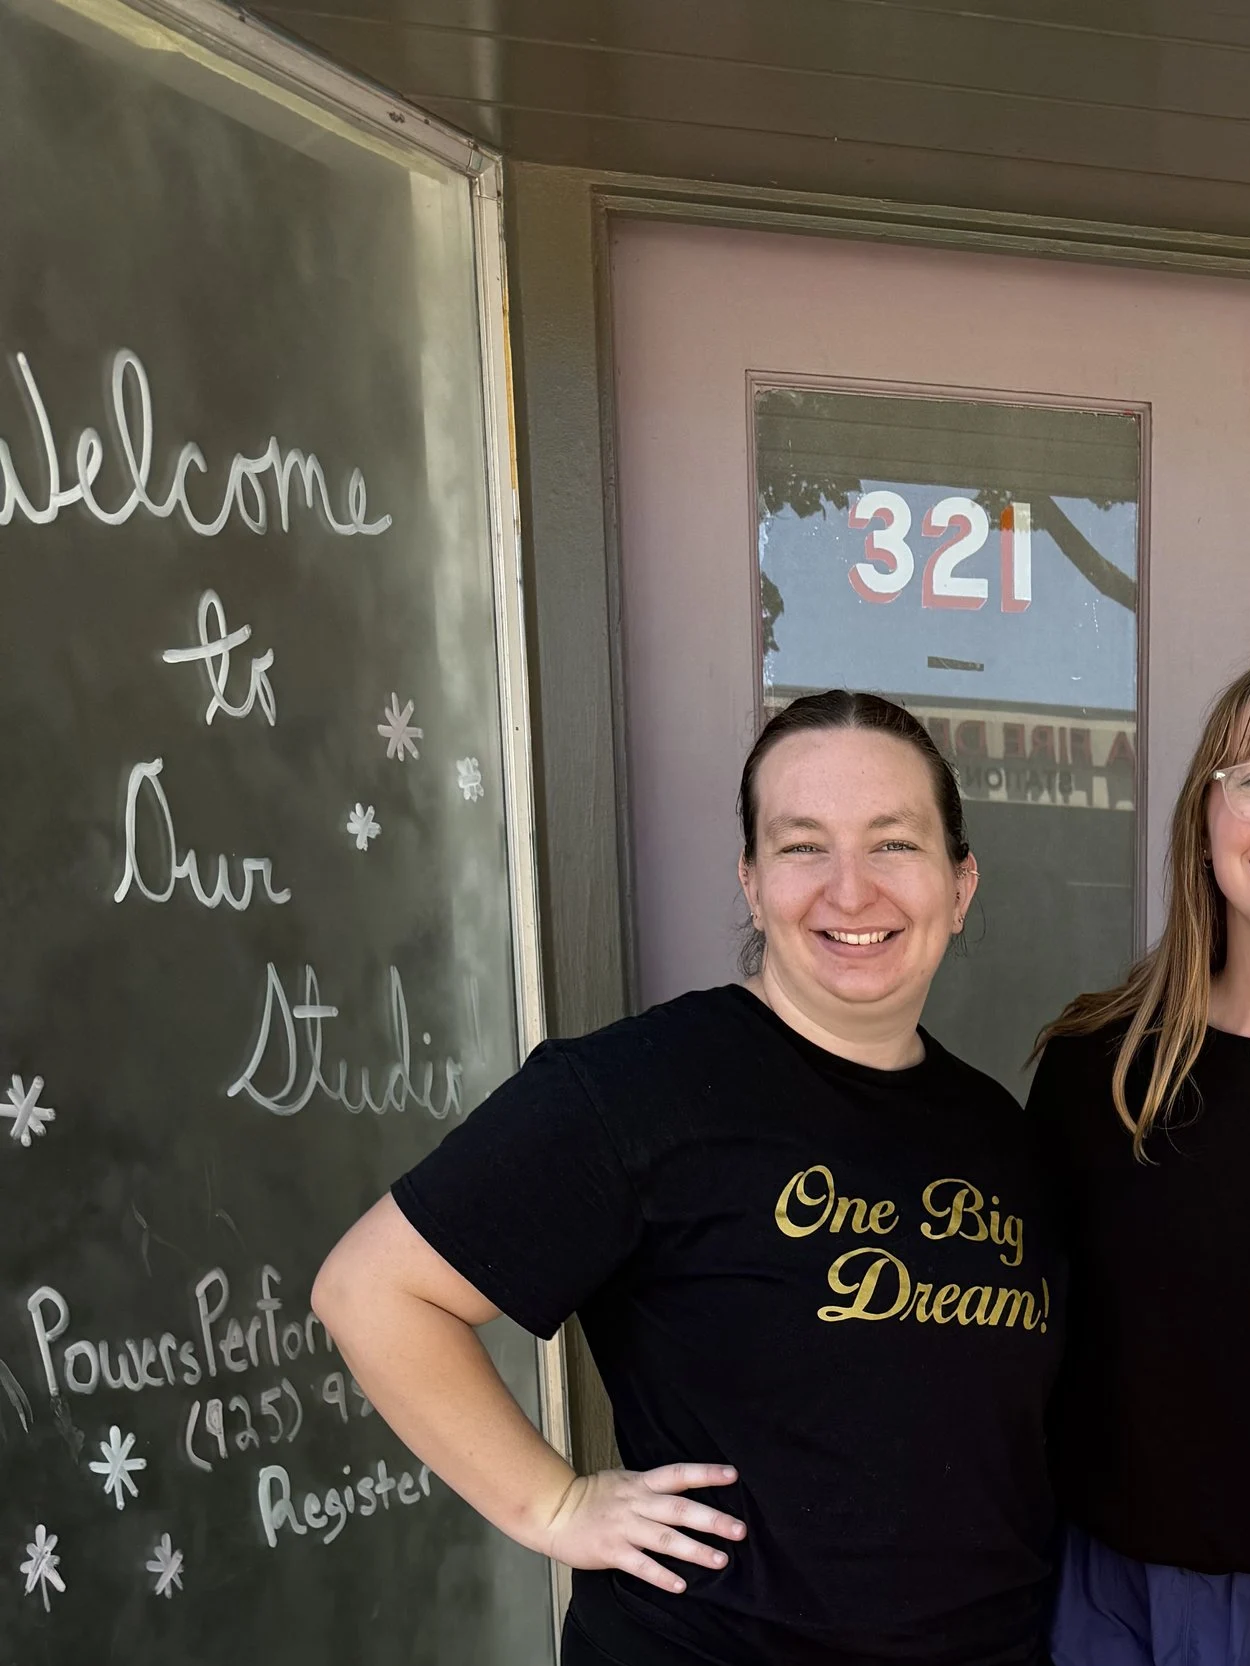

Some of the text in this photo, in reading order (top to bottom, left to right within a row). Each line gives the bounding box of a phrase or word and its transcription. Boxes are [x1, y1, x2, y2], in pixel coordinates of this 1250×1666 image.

[848, 490, 1032, 613] 321
[163, 588, 276, 726] to
[114, 758, 292, 912] Our
[775, 1165, 1023, 1267] One Big
[817, 1247, 1050, 1334] Dream!
[258, 1459, 432, 1548] Register
